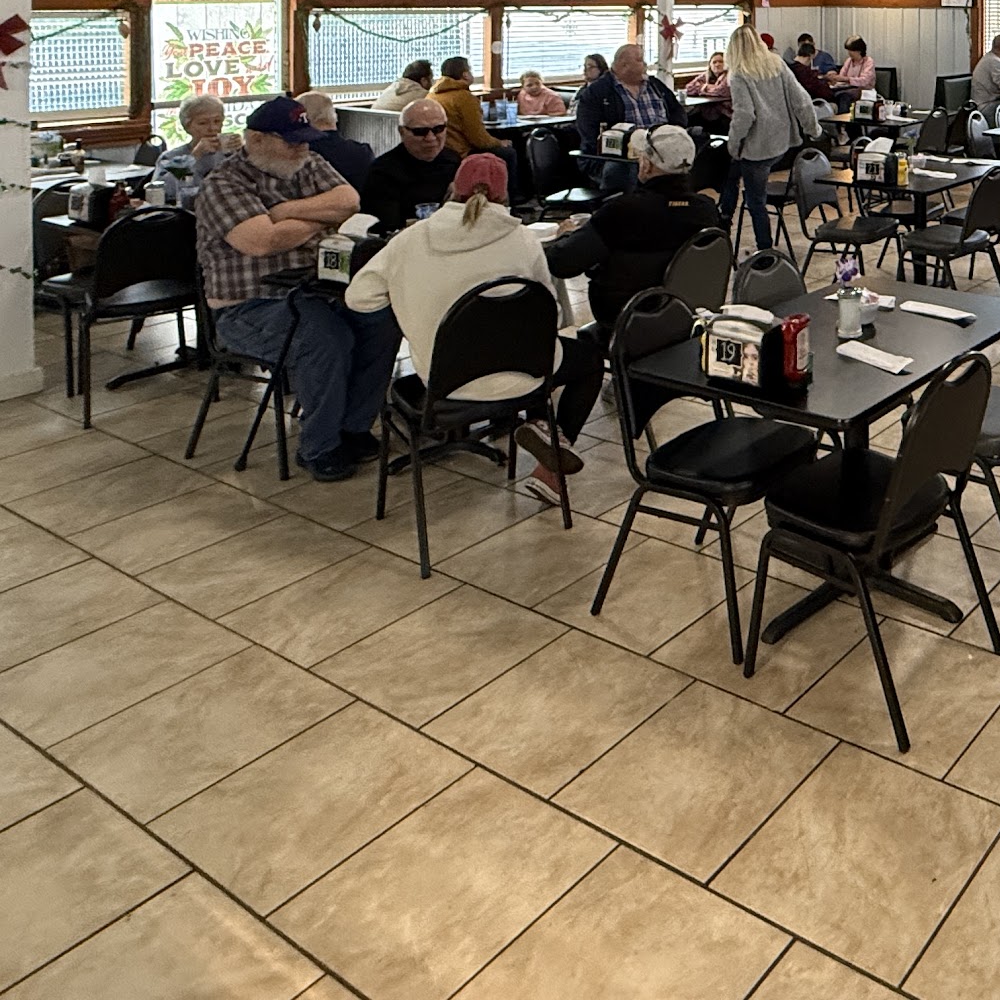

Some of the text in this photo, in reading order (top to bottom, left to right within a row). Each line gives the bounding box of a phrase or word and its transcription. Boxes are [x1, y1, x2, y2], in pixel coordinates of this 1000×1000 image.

[186, 28, 250, 40] WISHING
[165, 59, 240, 78] LOVE
[867, 164, 877, 174] 21
[326, 253, 337, 268] 18
[721, 341, 735, 361] 19
